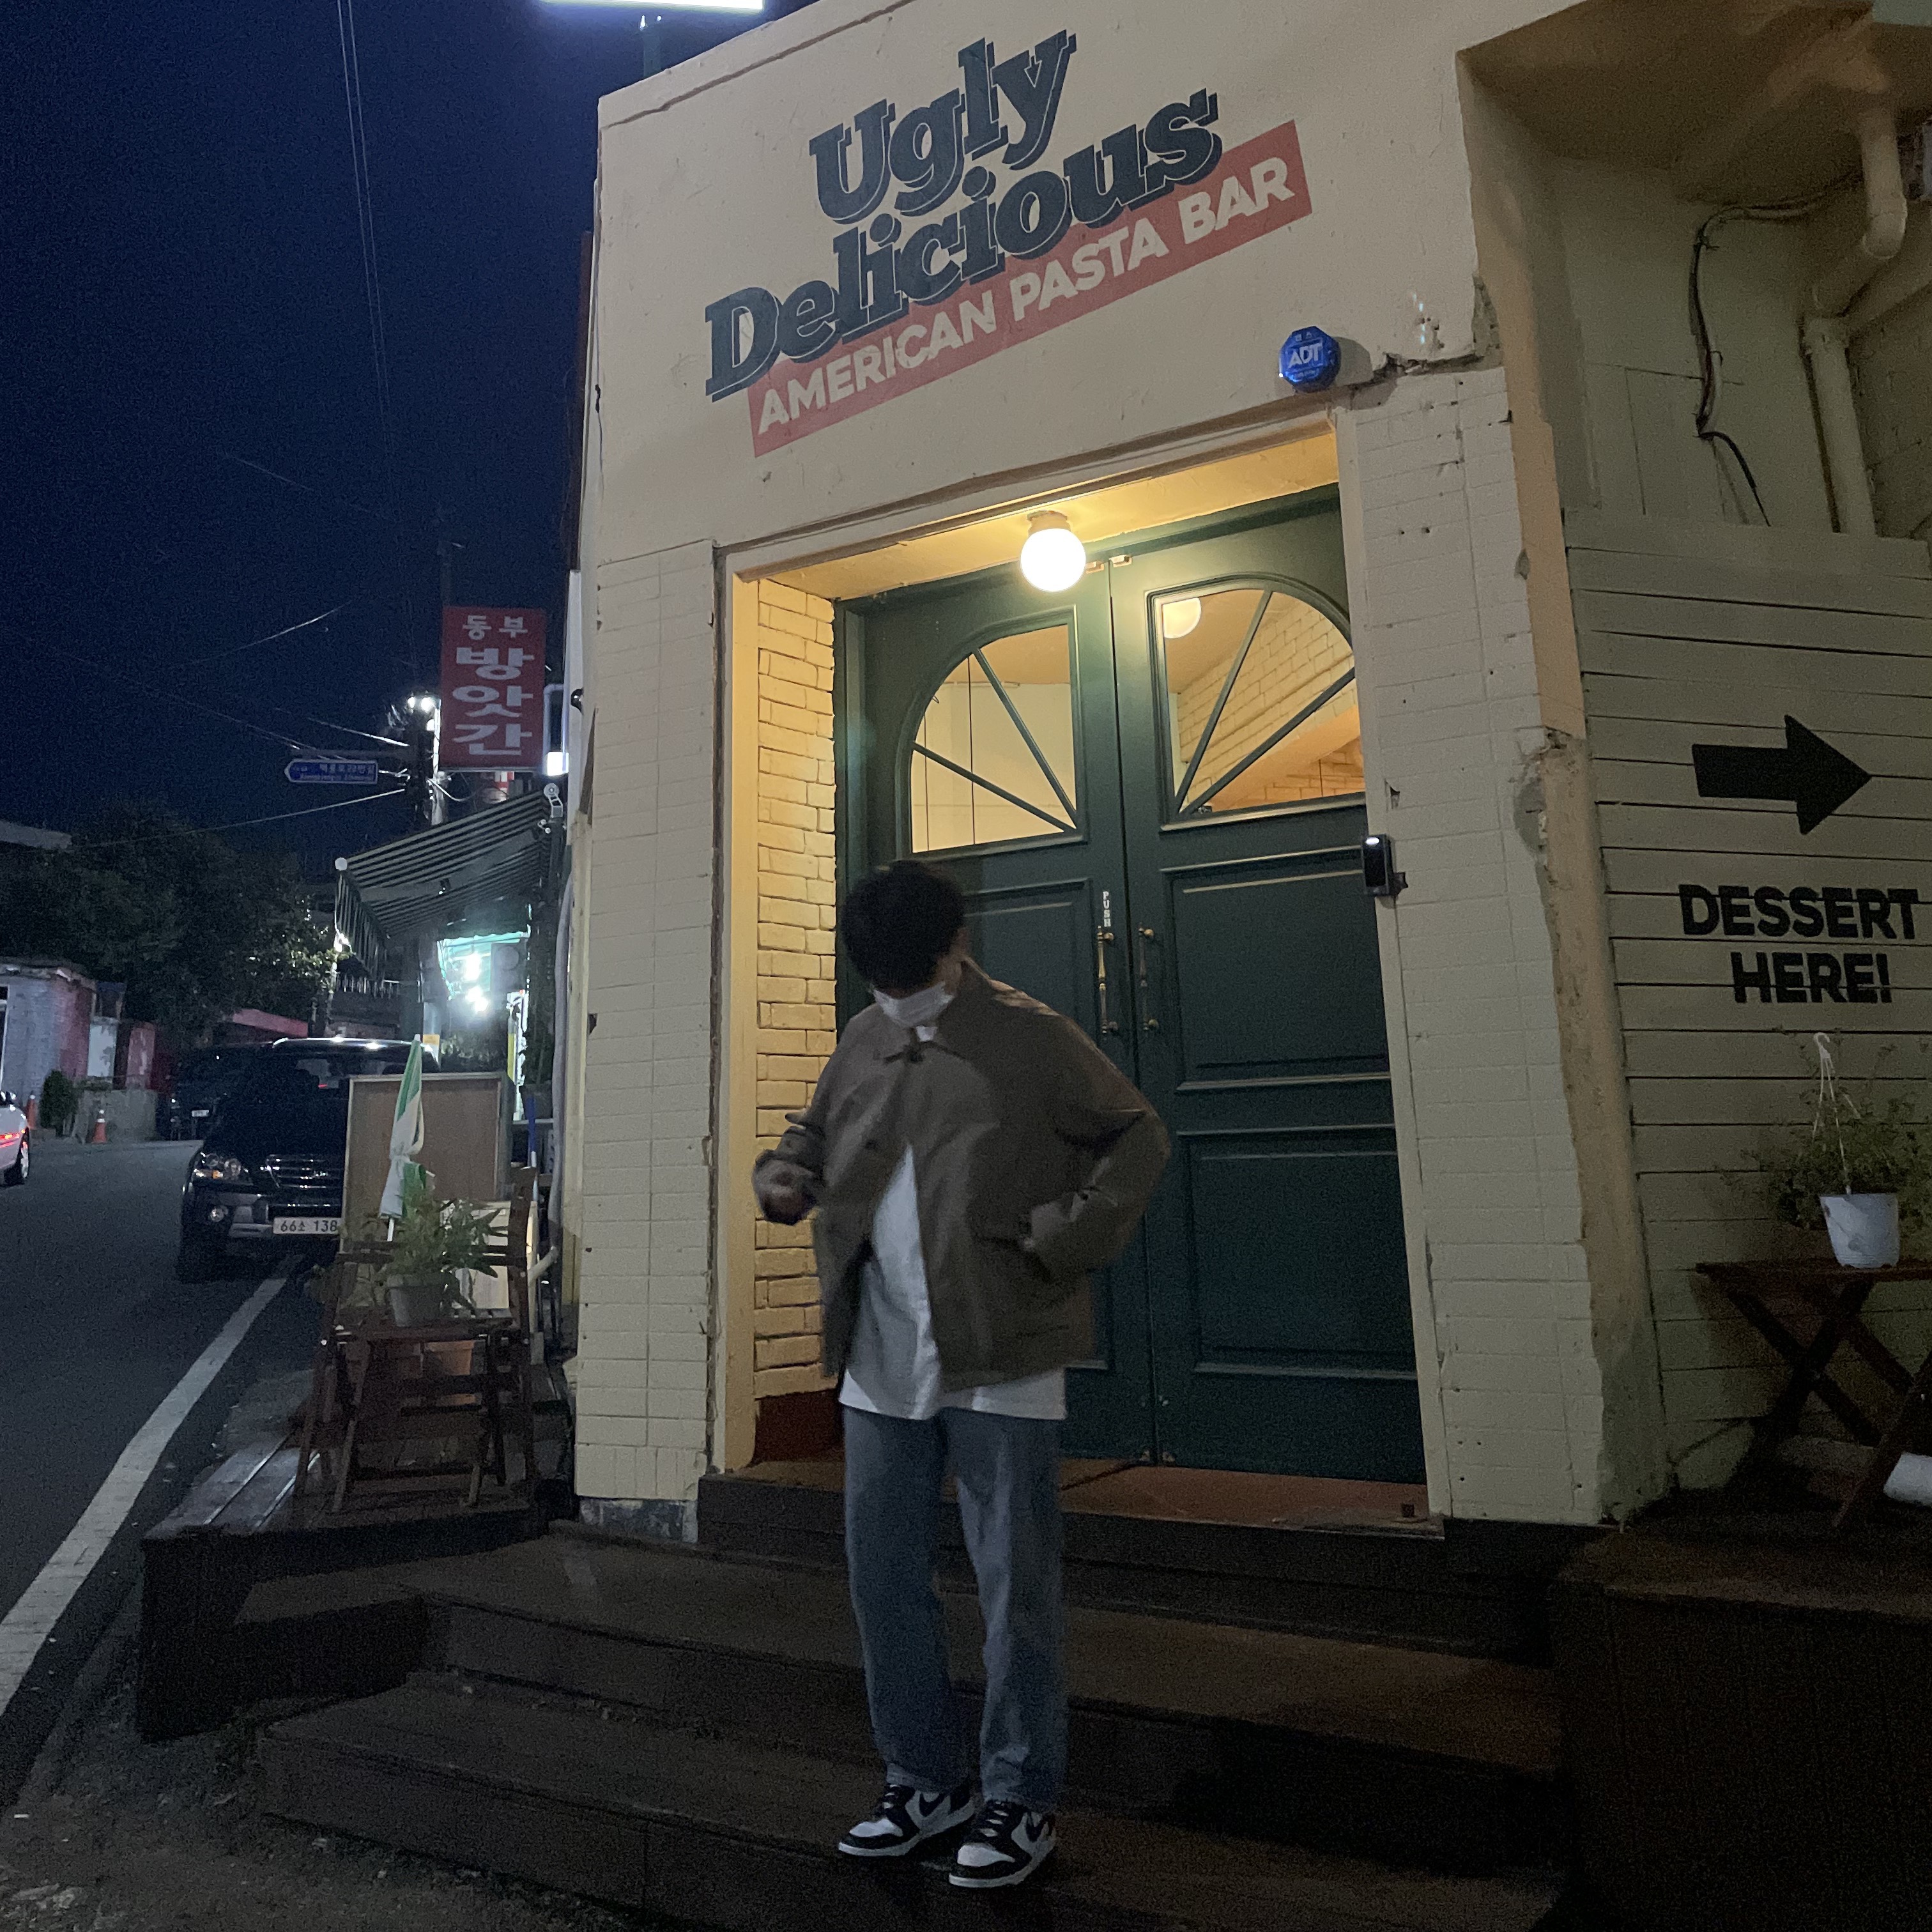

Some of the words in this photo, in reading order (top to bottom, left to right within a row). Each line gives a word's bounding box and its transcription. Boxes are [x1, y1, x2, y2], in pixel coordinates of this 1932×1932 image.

[809, 29, 1077, 225] Ugly
[705, 88, 1222, 402] Delicious
[757, 292, 997, 436] AMERICAN
[1011, 217, 1169, 324] PASTA
[1179, 157, 1296, 247] BAR
[1287, 342, 1323, 369] ADT
[462, 615, 528, 640] 동부
[452, 647, 535, 756] 방앗간
[1103, 891, 1111, 927] PUSH
[1678, 884, 1918, 939] DESSERT
[1730, 952, 1892, 1003] HERE!
